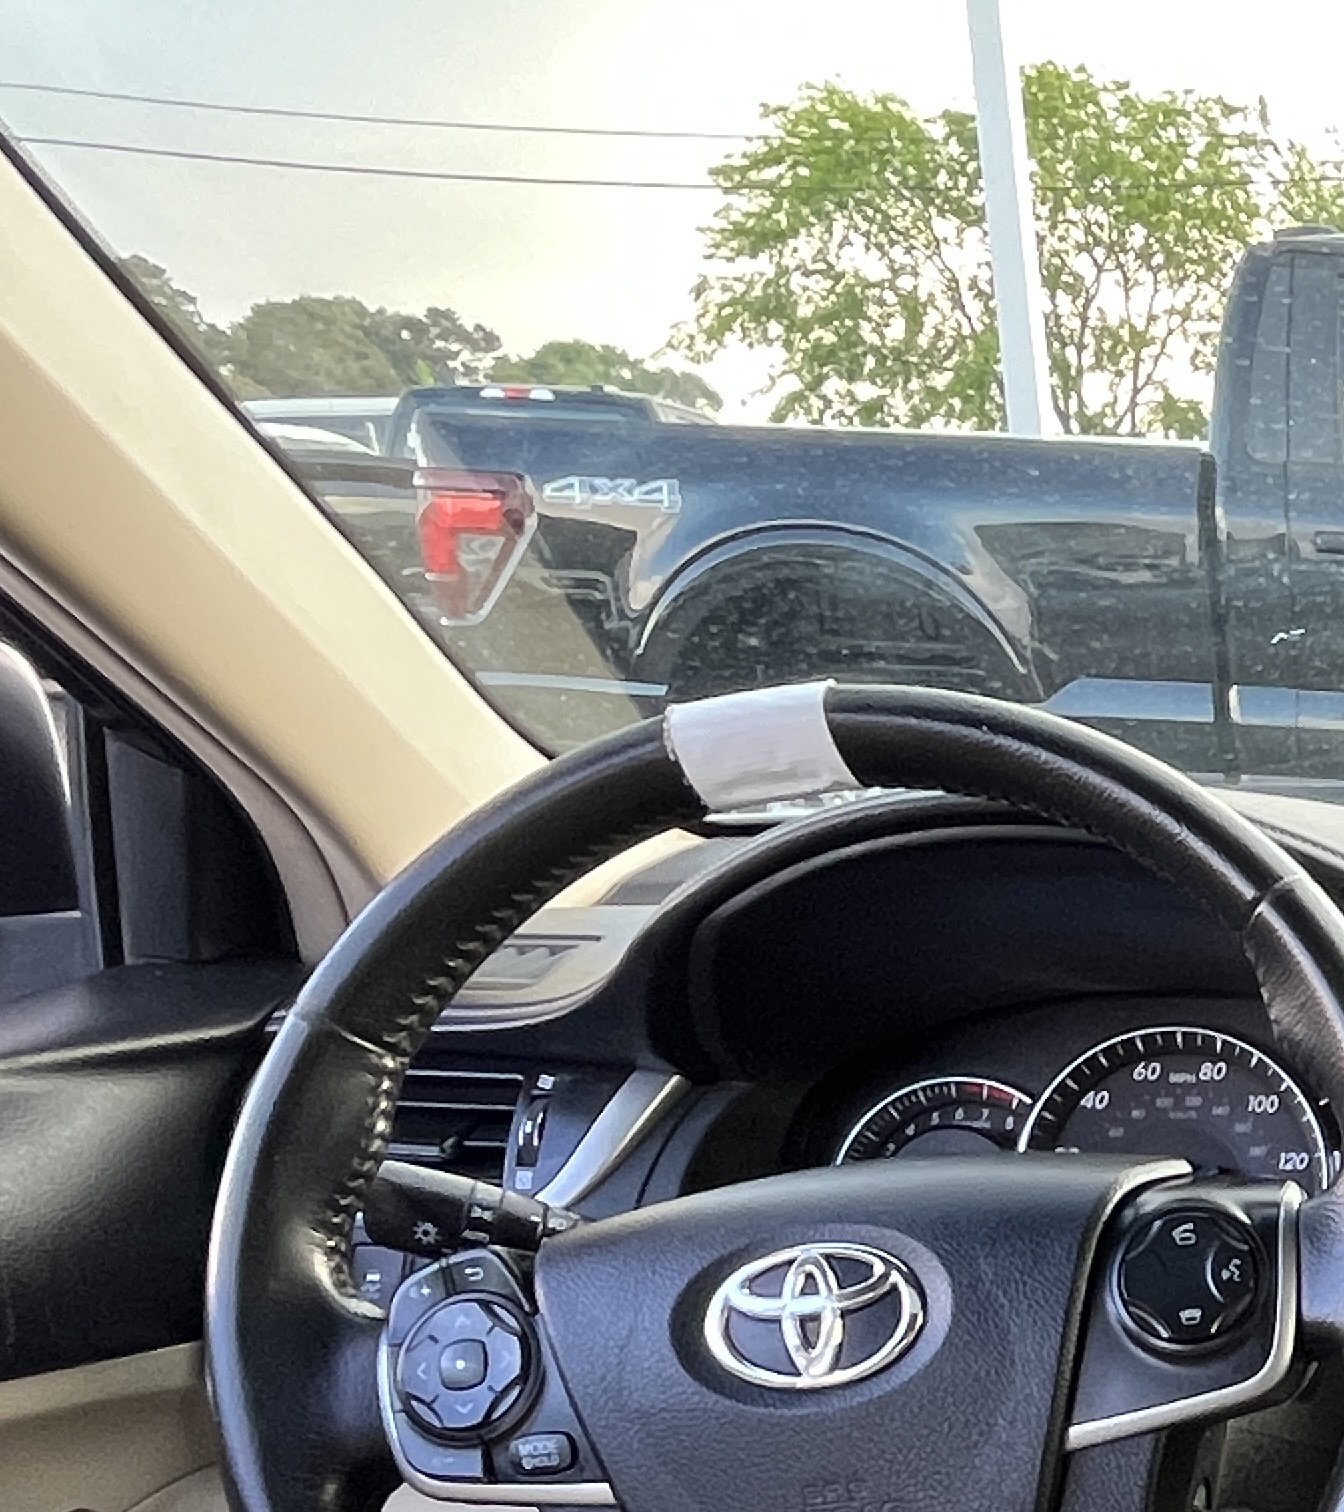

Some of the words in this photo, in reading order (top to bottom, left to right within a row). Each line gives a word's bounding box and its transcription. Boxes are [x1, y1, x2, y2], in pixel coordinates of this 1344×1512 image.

[1132, 1061, 1162, 1082] 60
[1199, 1061, 1228, 1082] 80
[1080, 1090, 1110, 1110] 40
[1248, 1094, 1280, 1114] 100
[1278, 1151, 1309, 1171] 120
